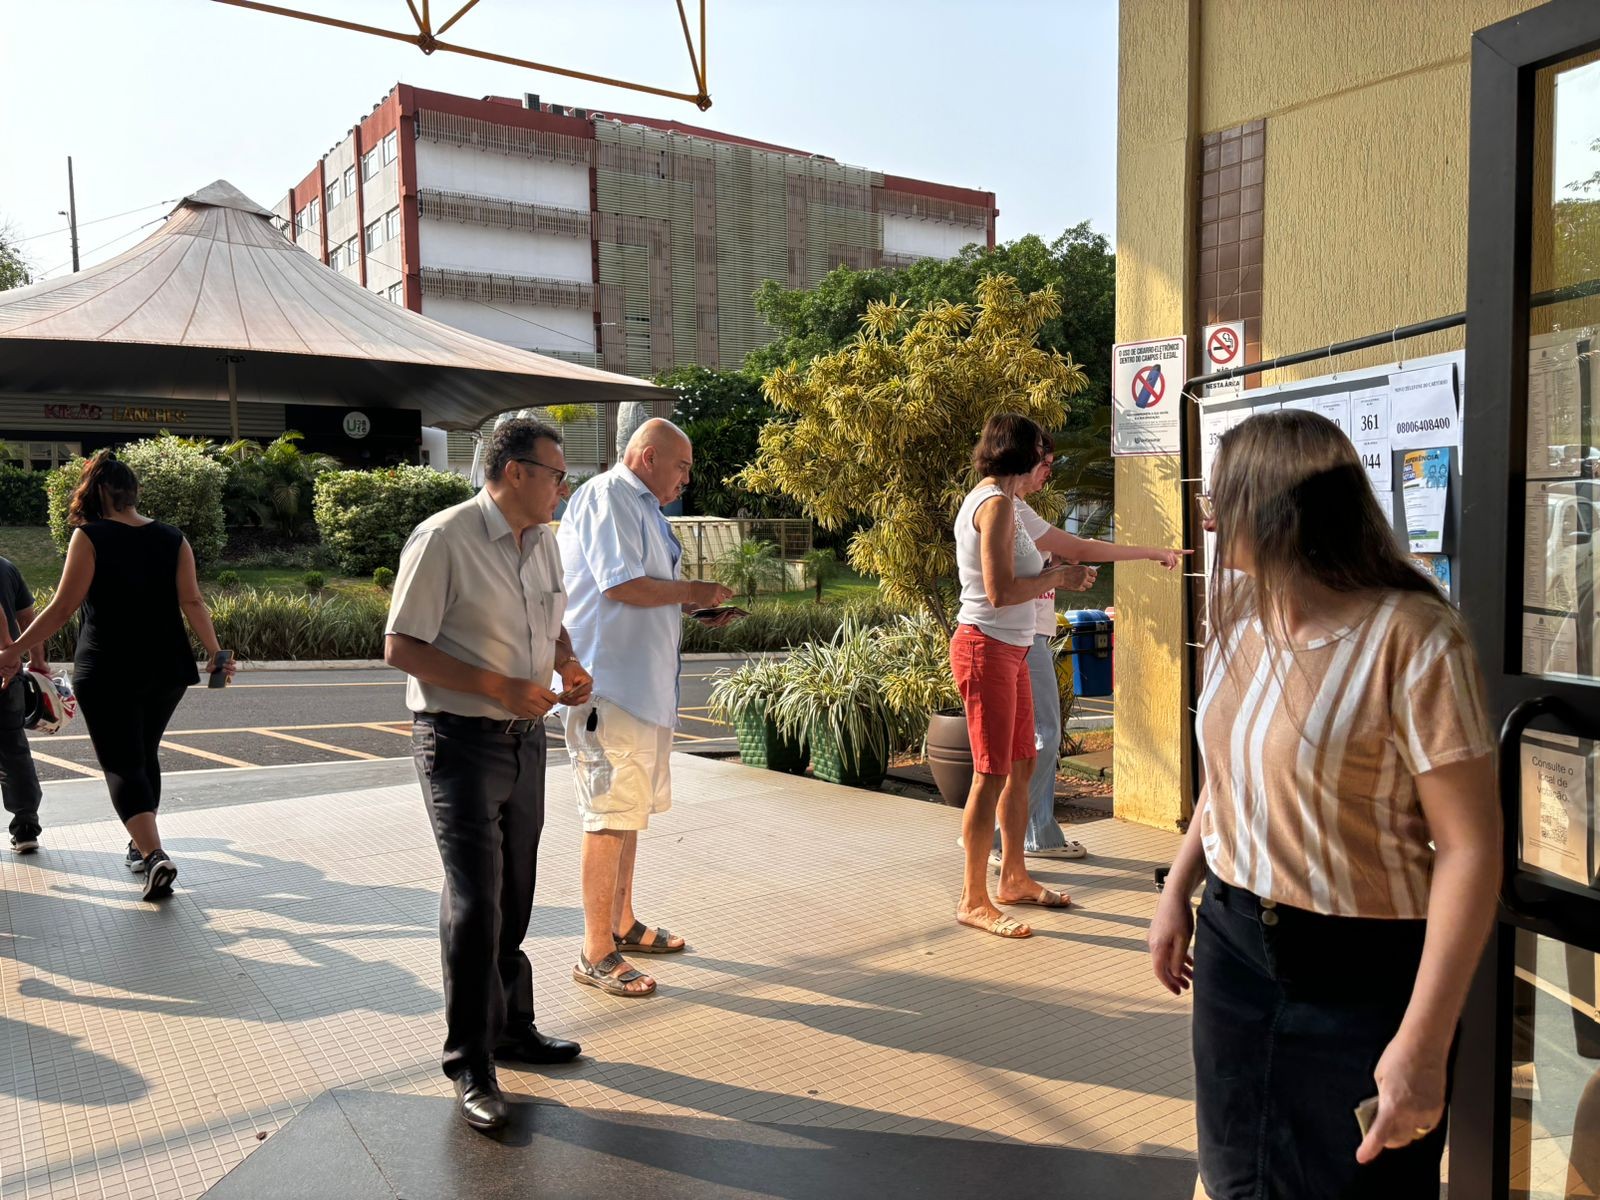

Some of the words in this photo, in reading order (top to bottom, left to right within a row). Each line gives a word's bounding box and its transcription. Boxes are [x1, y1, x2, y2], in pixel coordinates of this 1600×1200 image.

[1131, 348, 1137, 356] DE
[1135, 355, 1141, 363] DO
[1142, 353, 1159, 362] CAMPUS
[1205, 381, 1224, 389] NESTA
[1361, 413, 1380, 431] 361
[1397, 417, 1450, 434] 08006408400
[1208, 432, 1221, 446] 35
[1362, 453, 1381, 469] 044
[1532, 756, 1566, 774] Consulte
[1538, 771, 1555, 784] local
[1557, 777, 1568, 788] de
